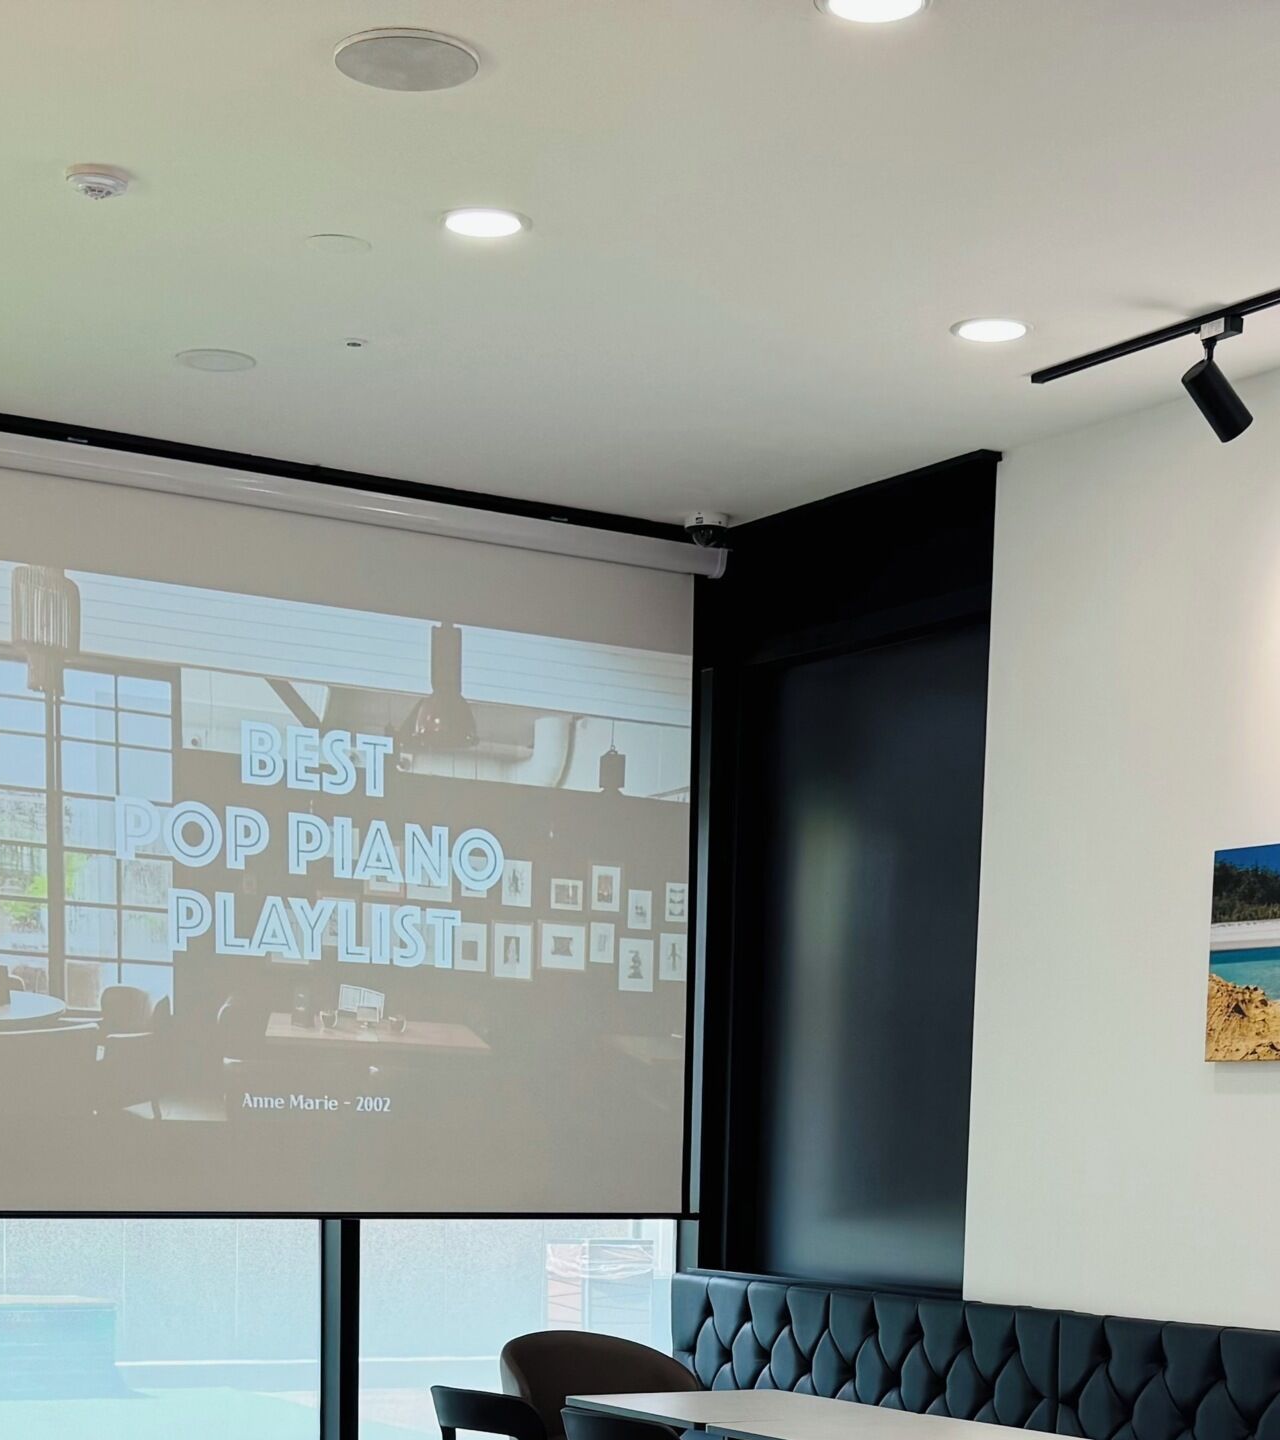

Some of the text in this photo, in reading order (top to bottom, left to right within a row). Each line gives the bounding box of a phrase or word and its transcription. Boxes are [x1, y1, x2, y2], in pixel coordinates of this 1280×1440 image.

[241, 720, 393, 797] BEST
[115, 795, 504, 892] POP PIANO
[168, 887, 461, 969] PLAYLIST
[242, 1093, 285, 1109] Anne
[290, 1094, 339, 1111] Marie
[356, 1096, 391, 1112] 2002
